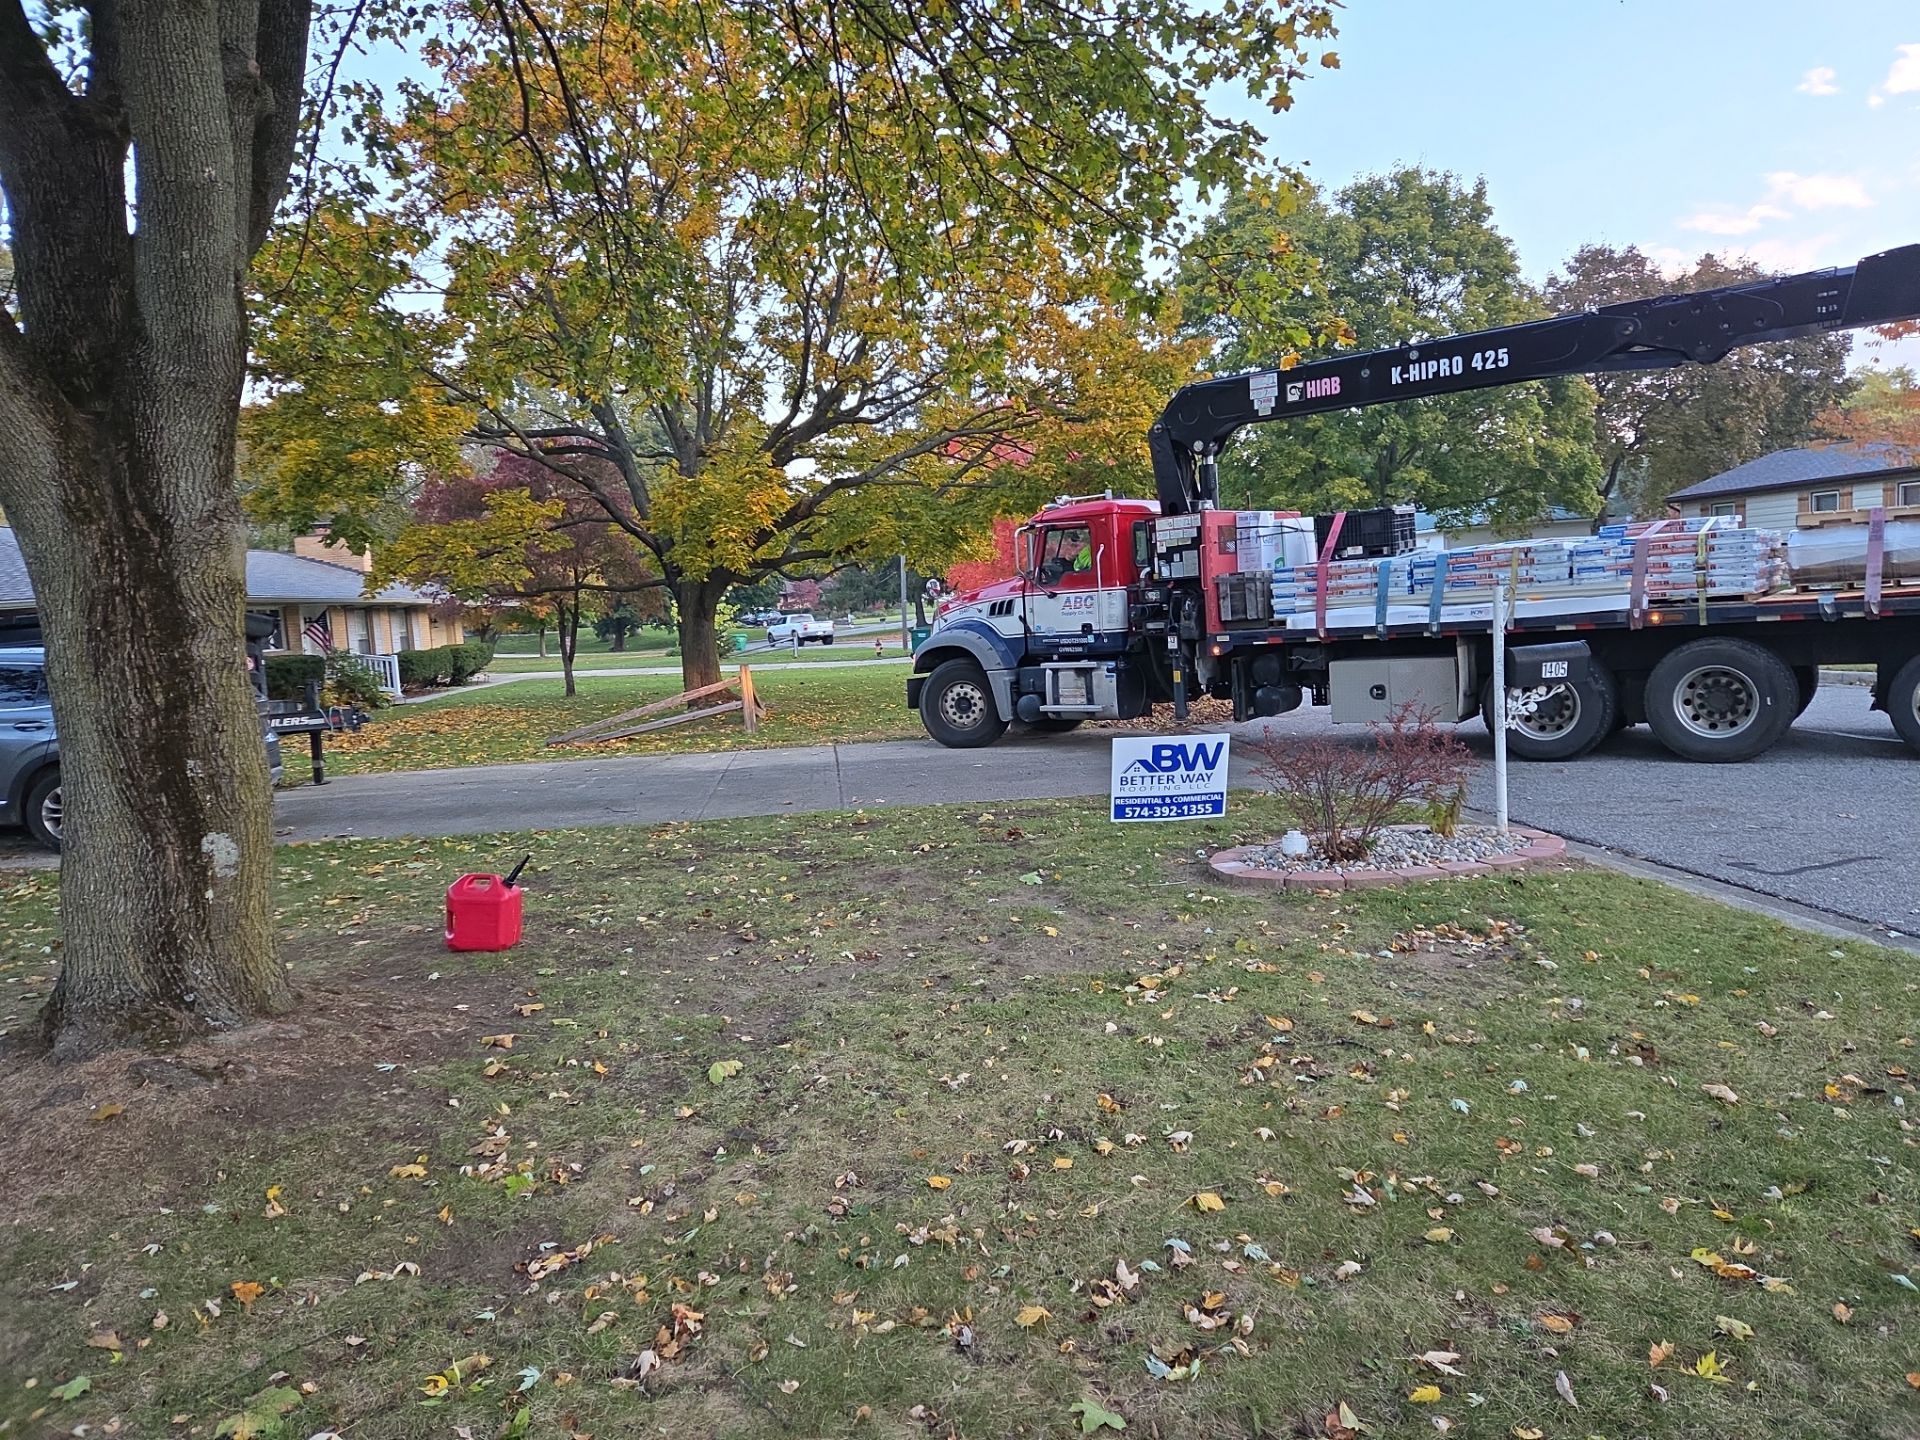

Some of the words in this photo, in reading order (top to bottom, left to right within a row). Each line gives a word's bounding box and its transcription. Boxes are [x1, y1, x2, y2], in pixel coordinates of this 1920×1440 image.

[1391, 355, 1464, 385] K-HIPRO
[1471, 347, 1510, 372] 425
[1306, 376, 1341, 398] HIAB
[1061, 594, 1095, 610] ABC
[1543, 662, 1567, 677] 1405
[1120, 775, 1175, 786] BETTER
[1180, 772, 1214, 784] WAY
[1115, 797, 1163, 805] RESIDENTIAL
[1173, 794, 1222, 803] COMMERCIAL
[1125, 804, 1213, 818] 574-392-1355
